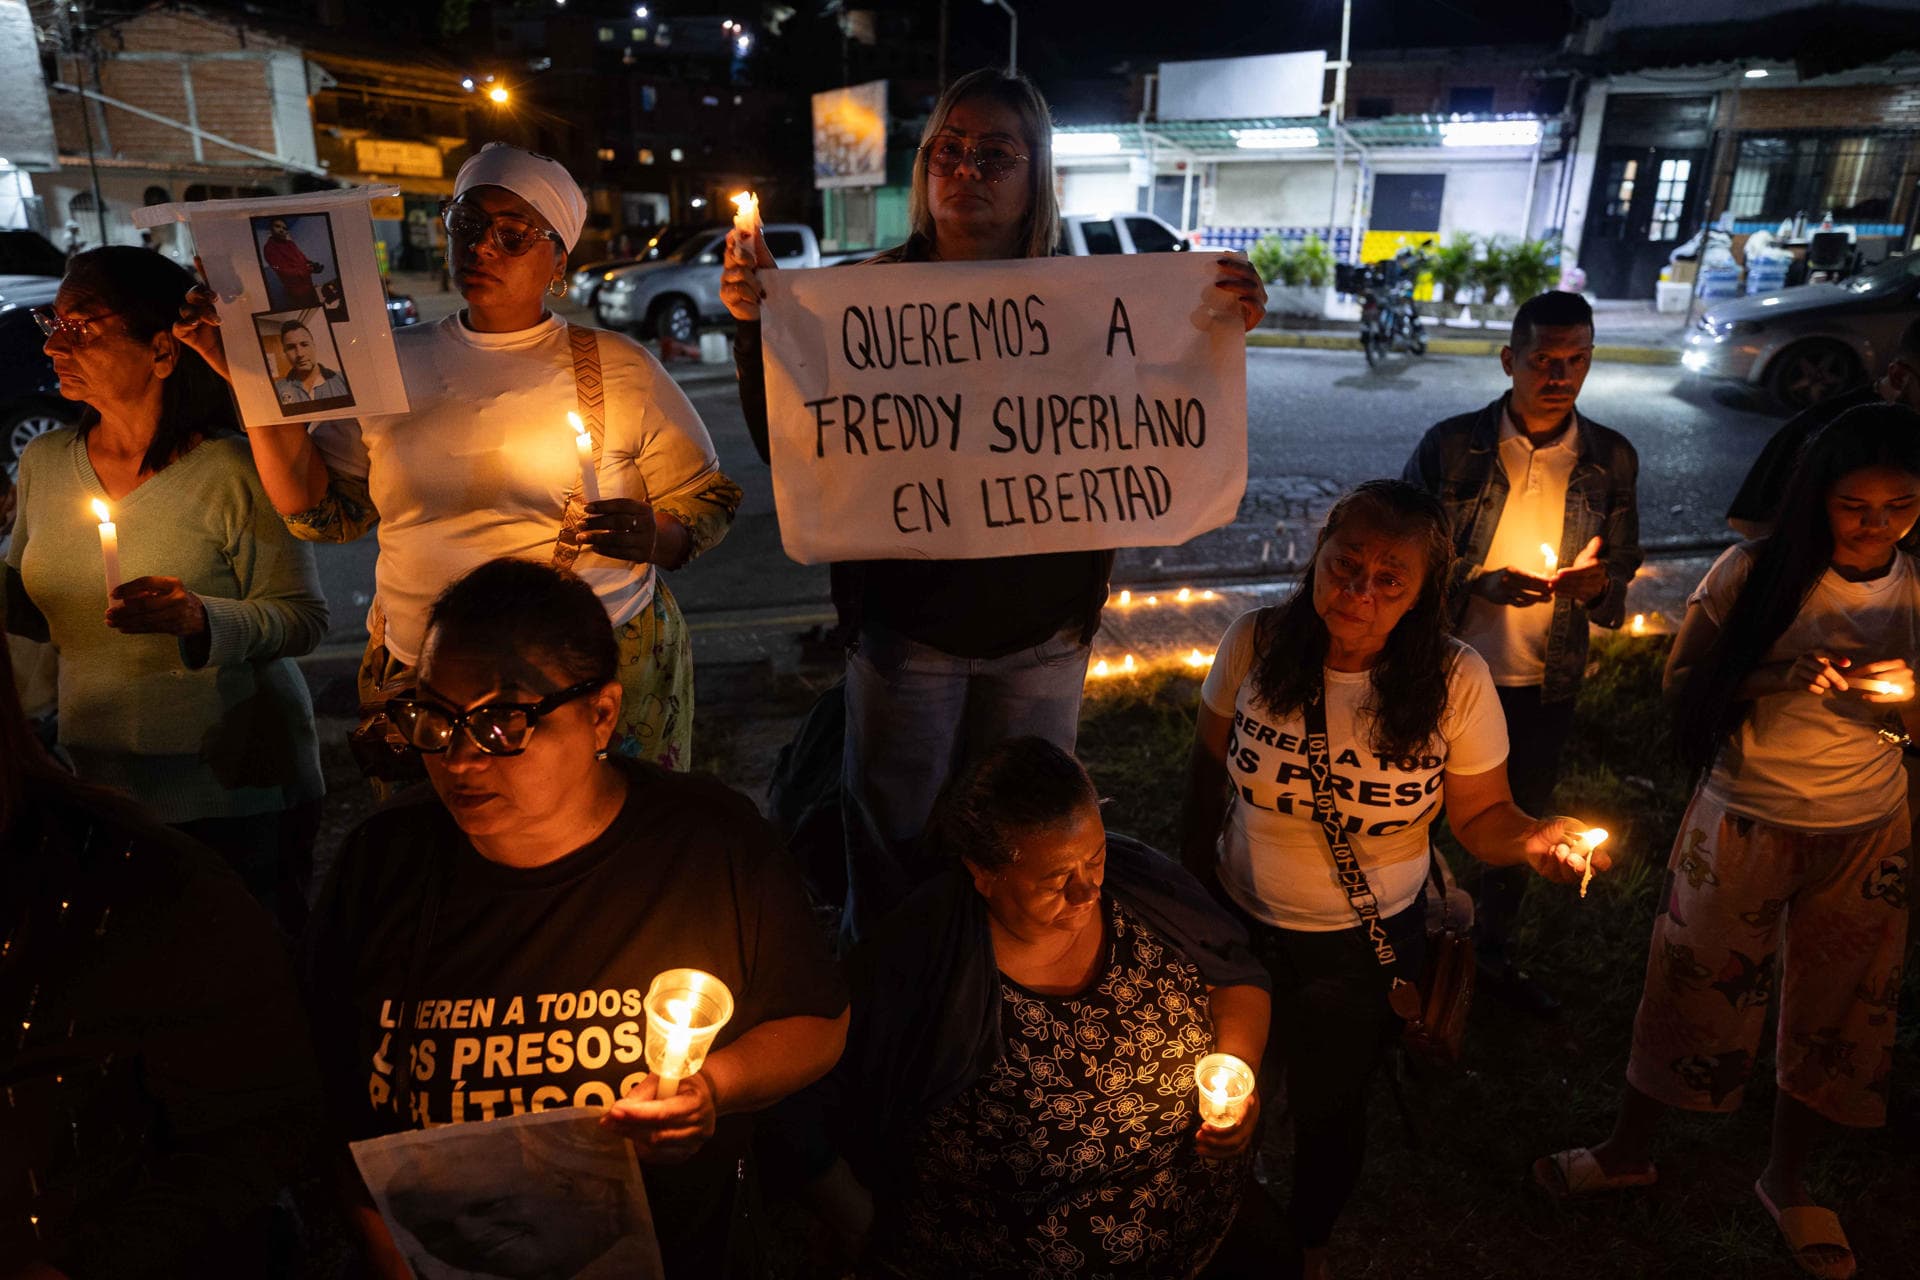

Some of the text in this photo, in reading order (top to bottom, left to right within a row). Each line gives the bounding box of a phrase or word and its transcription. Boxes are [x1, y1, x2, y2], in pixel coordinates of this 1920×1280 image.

[842, 294, 1136, 370] QUEREMOS A
[804, 393, 1206, 457] FREDDY SUPERLANO
[893, 465, 1172, 533] EN LIBERTAD
[1276, 762, 1444, 807] PRESO
[1335, 749, 1361, 768] A
[1373, 752, 1442, 772] TOD
[501, 996, 526, 1026] A
[536, 988, 642, 1023] TODOS
[372, 1021, 644, 1081] LS PRESOS
